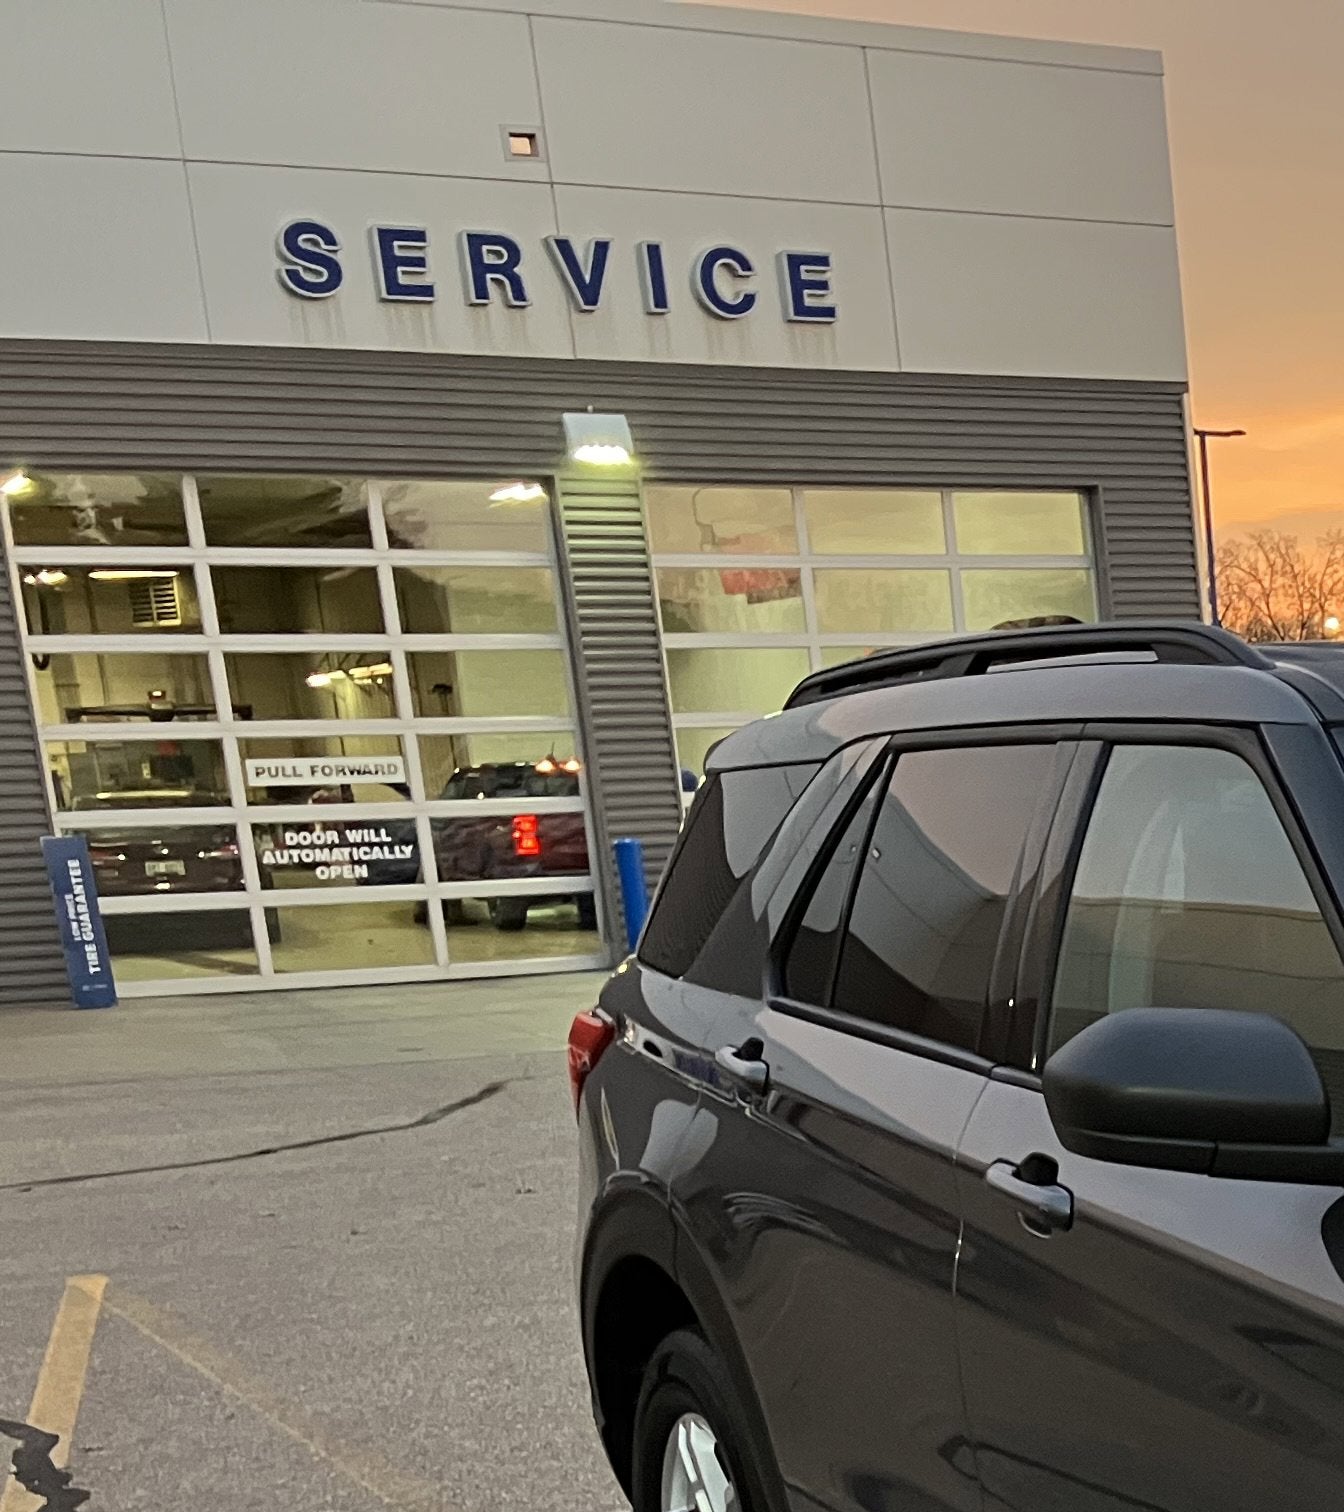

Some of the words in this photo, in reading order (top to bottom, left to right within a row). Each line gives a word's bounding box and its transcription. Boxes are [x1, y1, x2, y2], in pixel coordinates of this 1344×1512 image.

[277, 217, 838, 323] SERVICE
[254, 765, 304, 779] PULL
[309, 762, 399, 778] FORWARD
[284, 830, 340, 846] DOOR
[345, 827, 392, 844] WILL
[262, 844, 414, 865] AUTOMATICALLY
[315, 864, 369, 881] OPEN
[66, 858, 95, 942] GUARANTEE
[84, 943, 102, 976] TIRE
